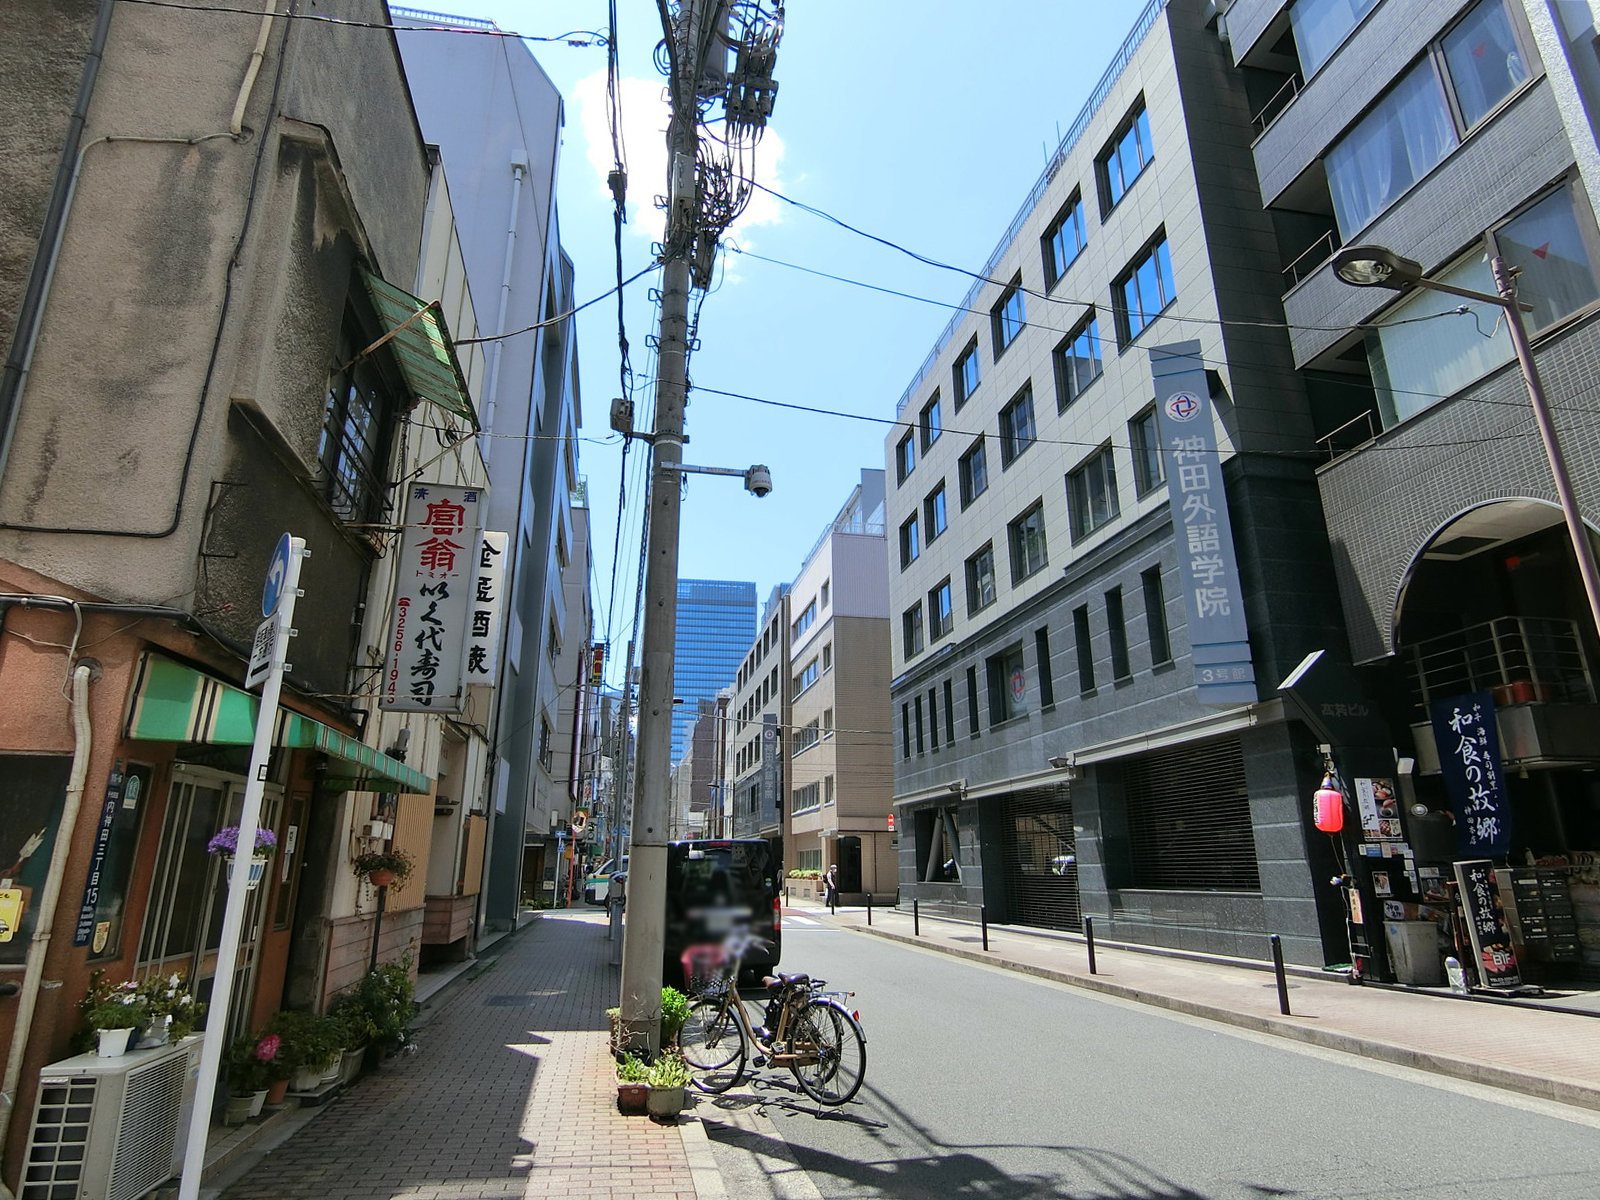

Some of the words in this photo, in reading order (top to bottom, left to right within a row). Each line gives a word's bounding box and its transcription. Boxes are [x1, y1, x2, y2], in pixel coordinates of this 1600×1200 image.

[1172, 434, 1231, 618] 神田外語学院
[1447, 707, 1499, 845] 和食の故郷
[85, 887, 99, 905] 15
[1468, 868, 1497, 935] 和食の故郷
